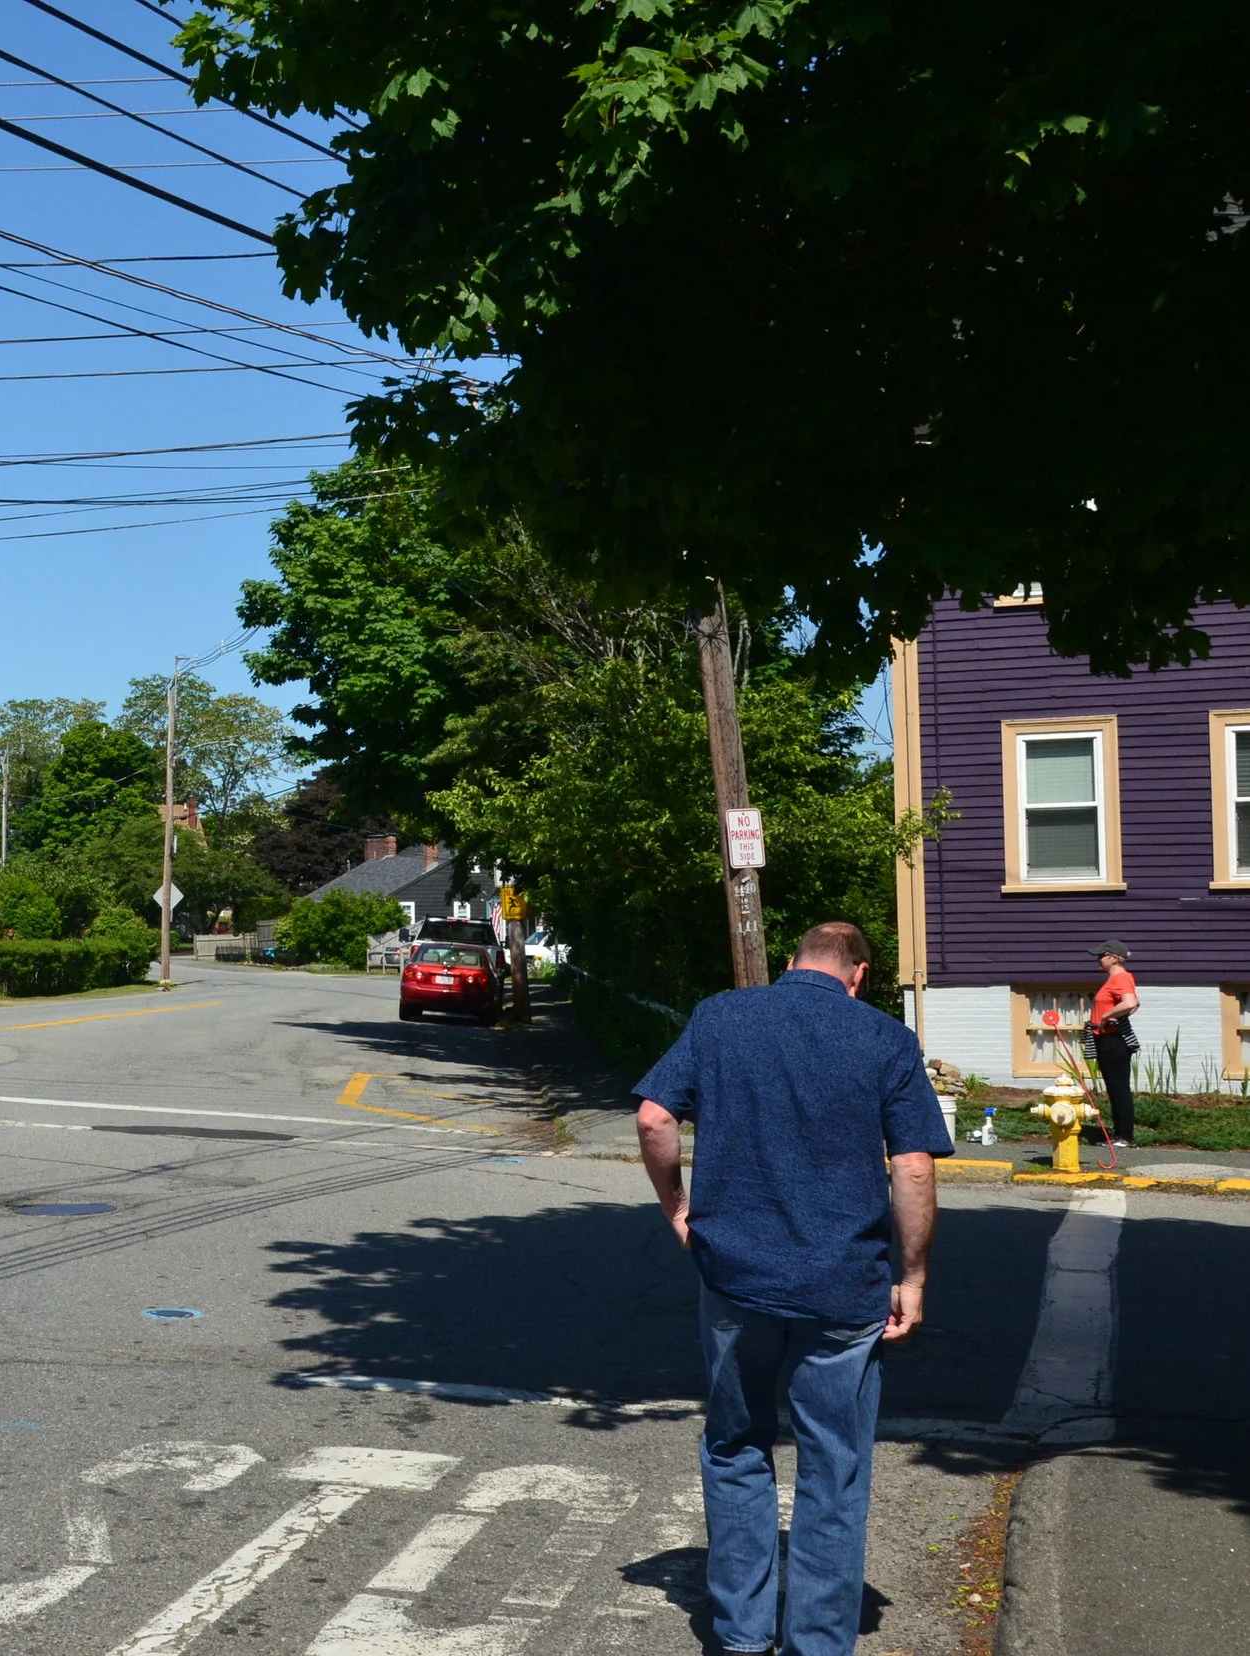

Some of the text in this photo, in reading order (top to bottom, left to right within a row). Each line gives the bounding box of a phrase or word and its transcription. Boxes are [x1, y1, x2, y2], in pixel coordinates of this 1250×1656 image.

[737, 816, 751, 827] NO
[731, 829, 760, 841] PARKING
[740, 843, 754, 851] THIS
[740, 852, 755, 861] SIDE
